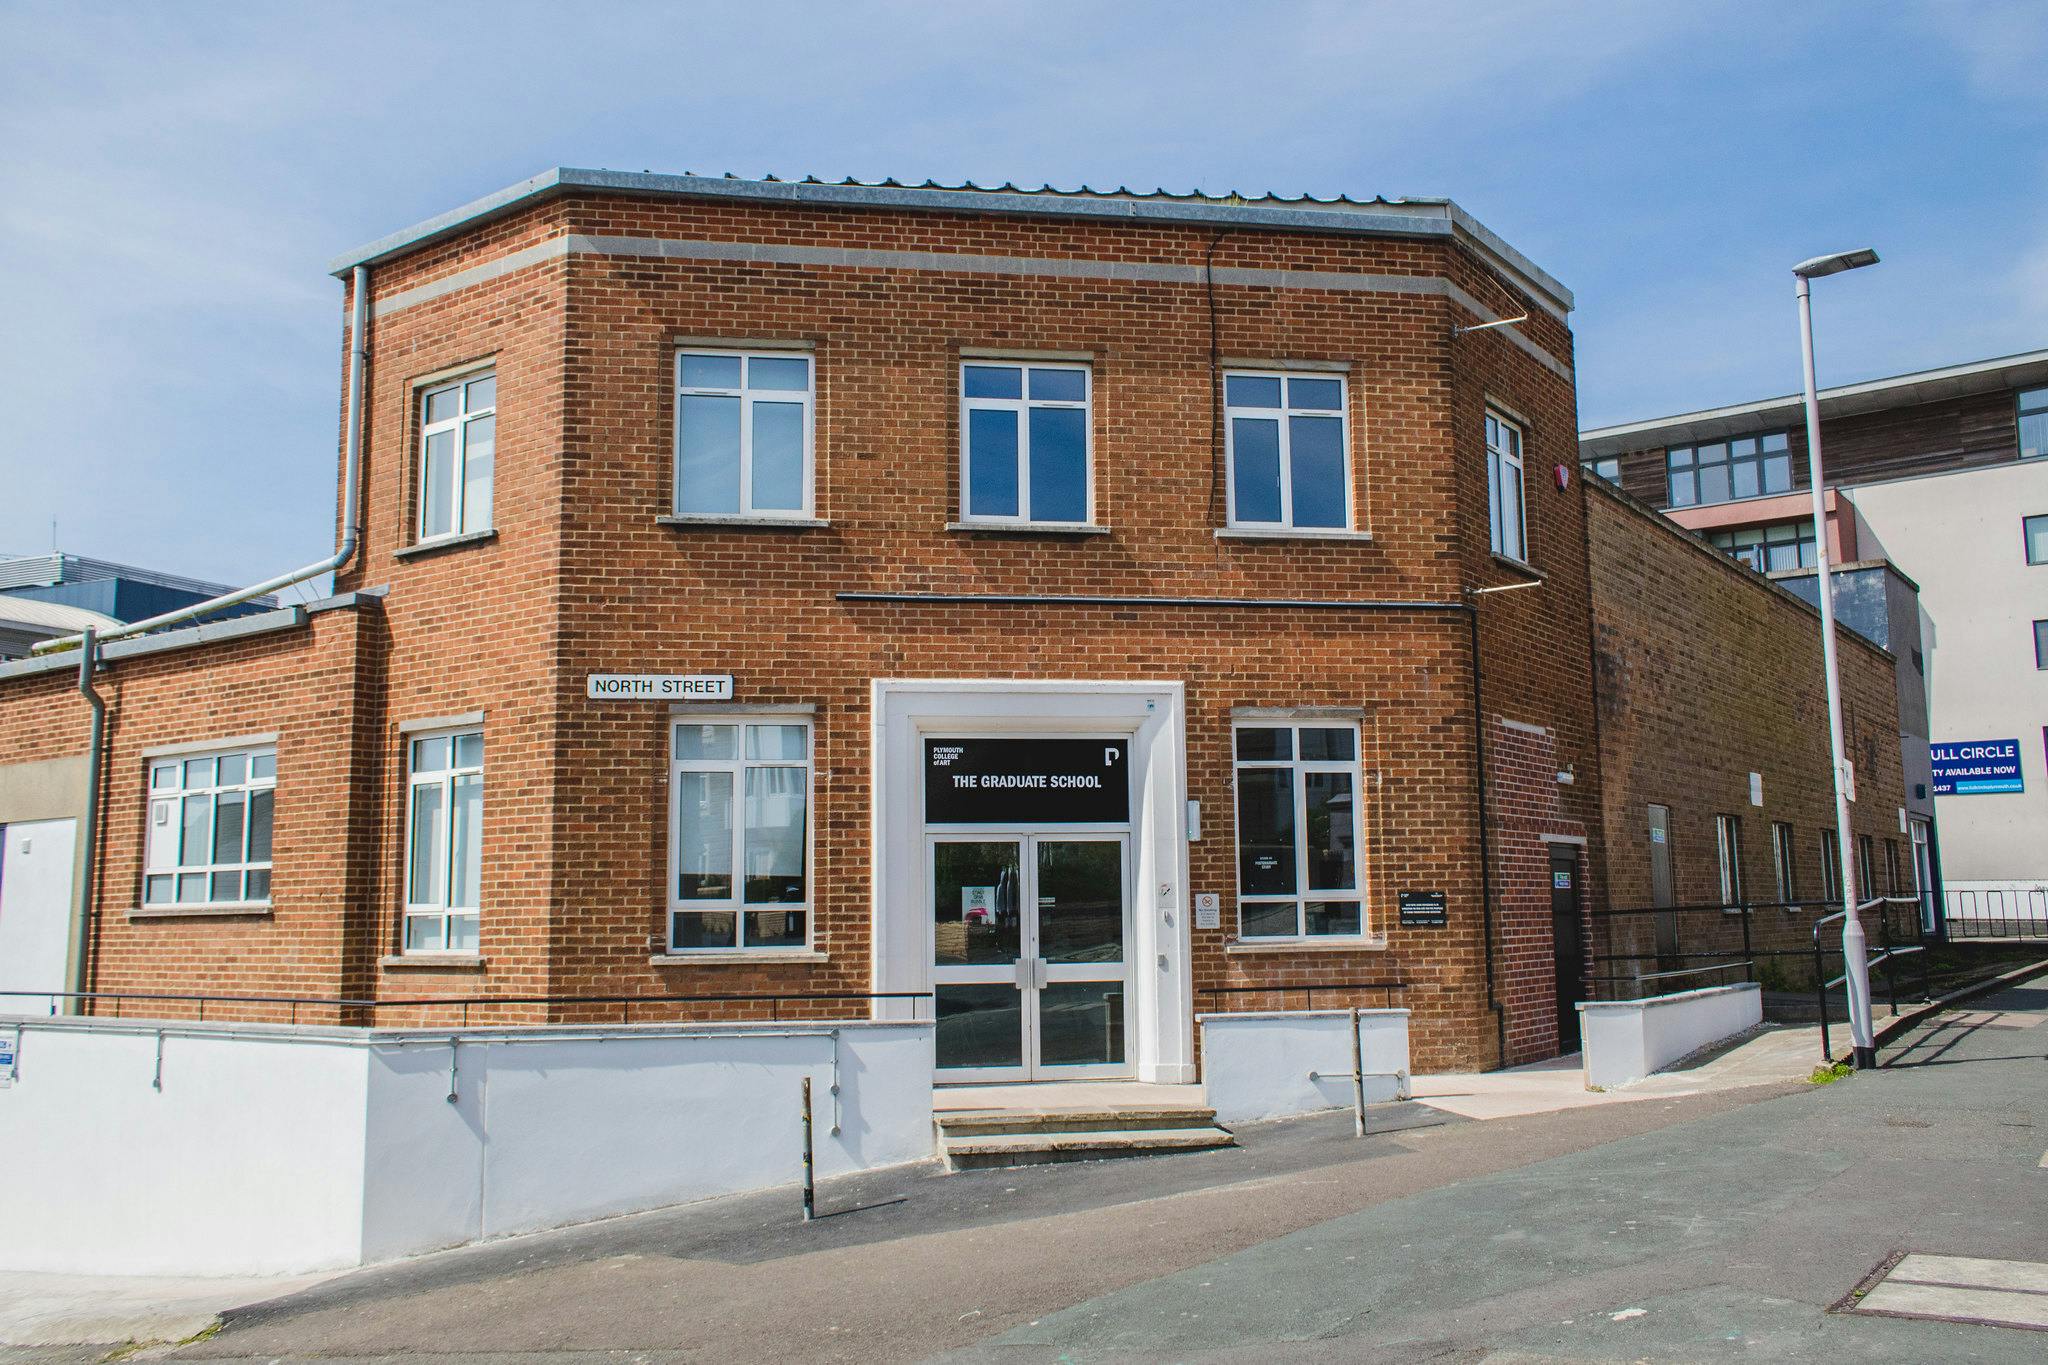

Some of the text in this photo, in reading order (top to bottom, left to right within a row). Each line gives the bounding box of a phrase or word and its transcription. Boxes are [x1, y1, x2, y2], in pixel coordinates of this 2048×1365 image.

[595, 680, 726, 693] NORTH STREET
[1960, 745, 2015, 759] CIRCLE
[1945, 766, 1992, 777] AVAILABLE
[1993, 765, 2016, 775] NOW
[952, 775, 1102, 788] THE GRADUATE SCHOOL
[1933, 784, 1951, 792] 1437
